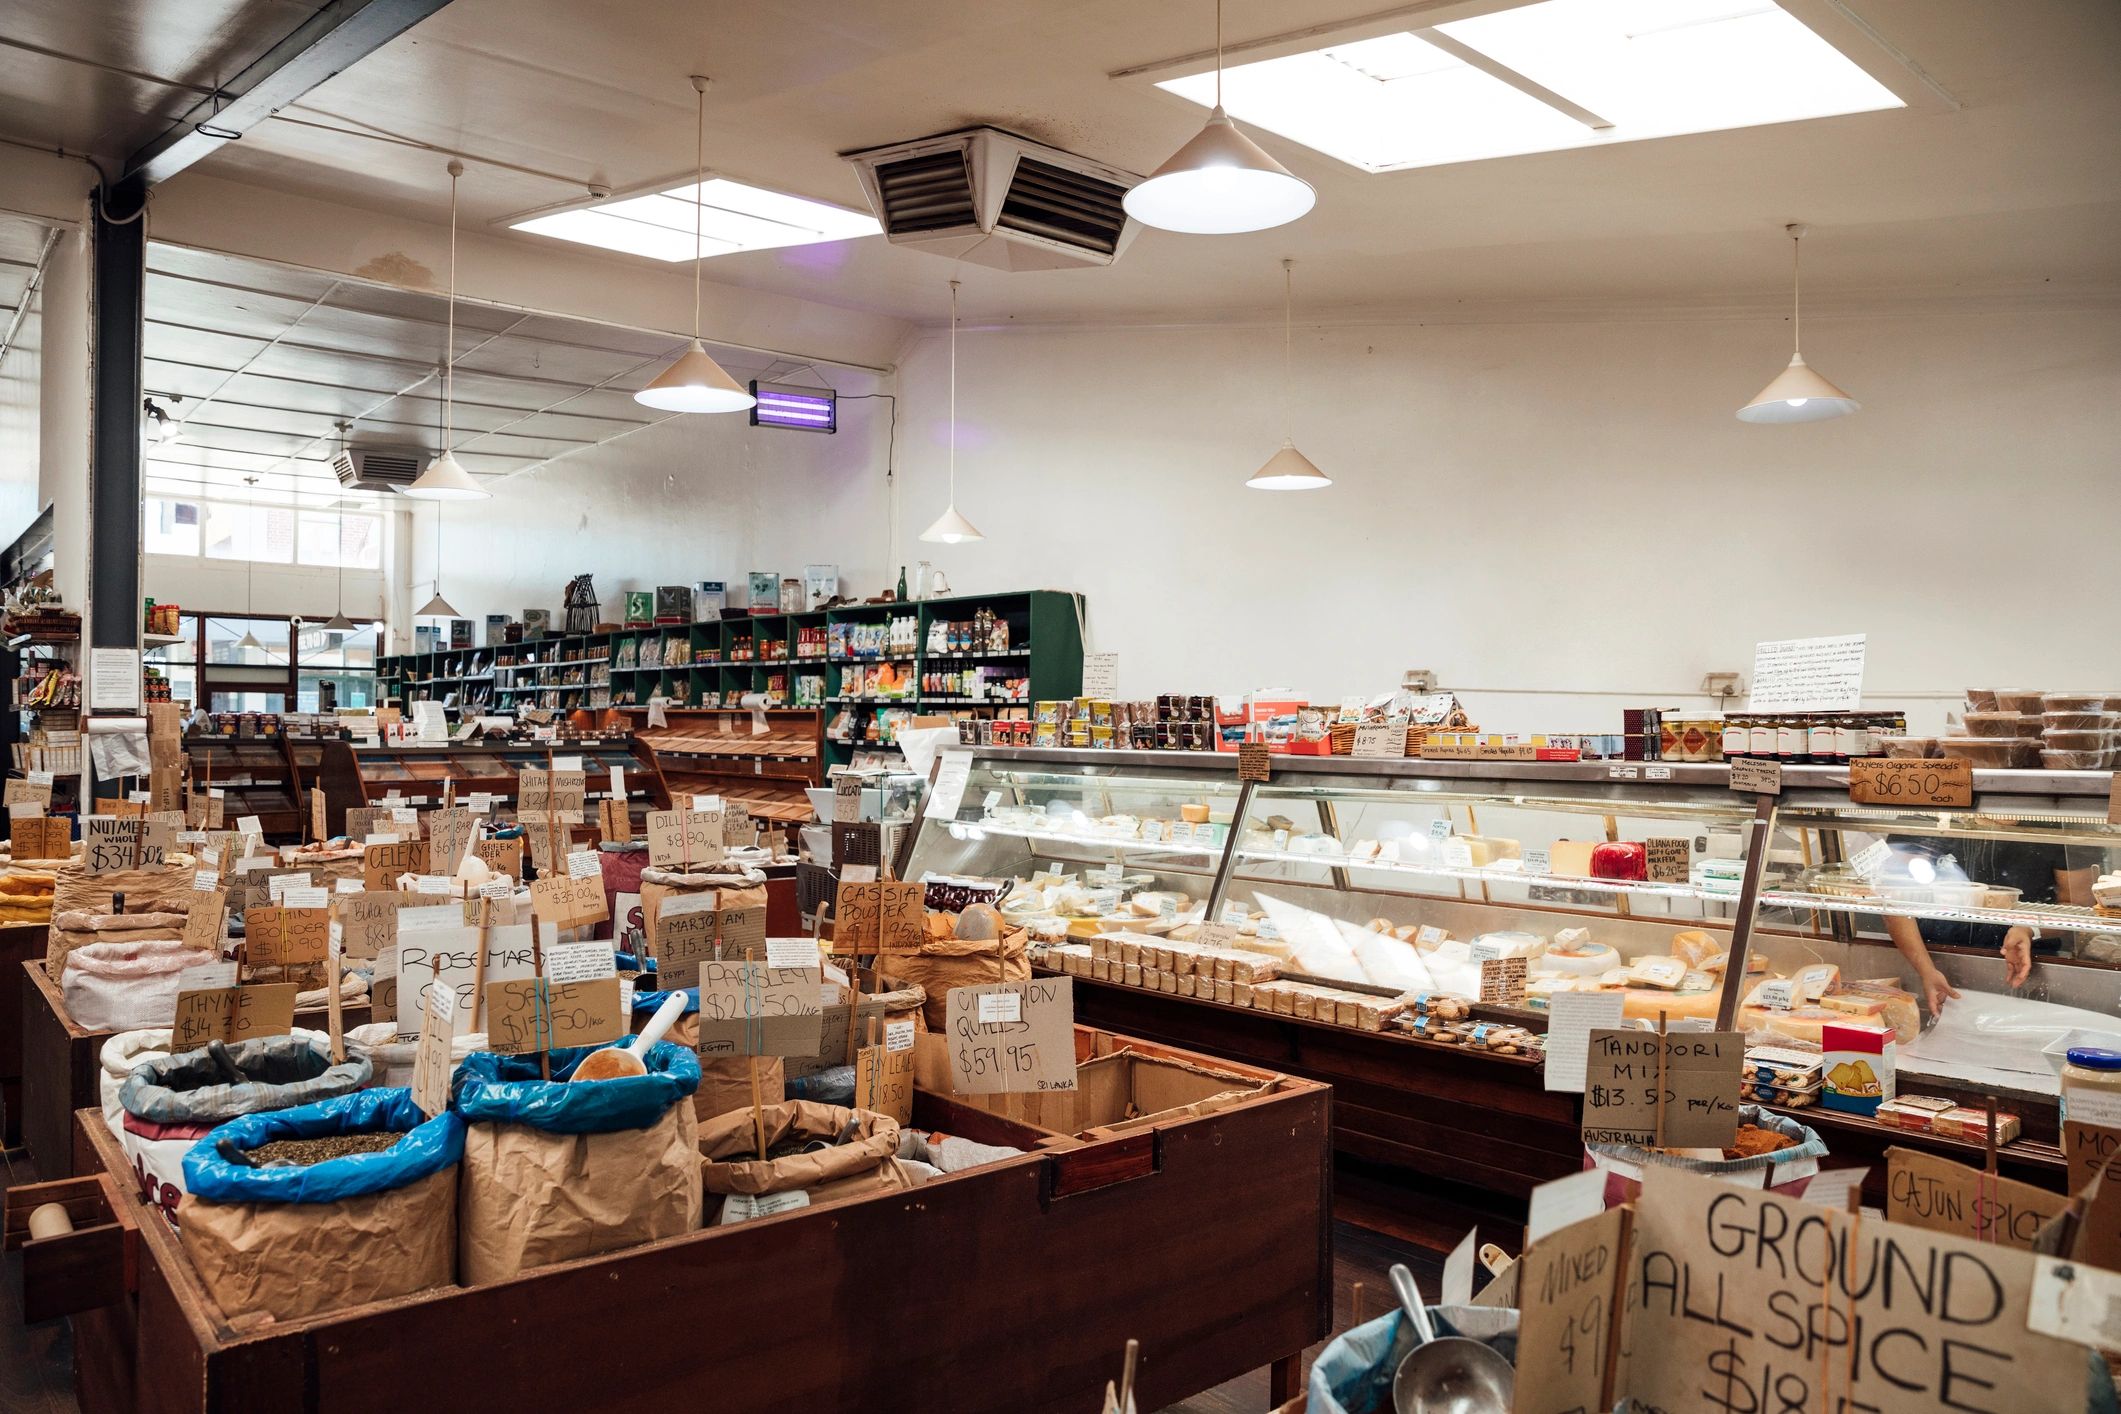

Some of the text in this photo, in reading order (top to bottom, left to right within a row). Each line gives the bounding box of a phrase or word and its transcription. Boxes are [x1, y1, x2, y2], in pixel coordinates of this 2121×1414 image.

[1885, 761, 1918, 773] Organic
[1920, 760, 1960, 771] Spreads
[1930, 795, 1955, 803] each
[655, 815, 682, 830] DILL
[686, 812, 719, 825] SEED
[369, 844, 425, 870] CELERY
[536, 882, 561, 895] DILL
[841, 885, 919, 903] CASSIA
[246, 908, 313, 926] CUMIN
[840, 902, 907, 921] POWDER
[255, 922, 326, 939] POWDER
[668, 912, 746, 934] MARJOAM
[663, 969, 686, 981] EGYPT
[707, 963, 809, 989] PARSLEY
[700, 1043, 732, 1053] EGYPT
[1036, 1079, 1074, 1090] SRI LANKA
[1583, 1129, 1656, 1145] AUSTRALIA
[1892, 1170, 1963, 1221] CAJUN
[1707, 1192, 2007, 1327] GROUND
[1641, 1250, 2014, 1414] ALL SPICE
